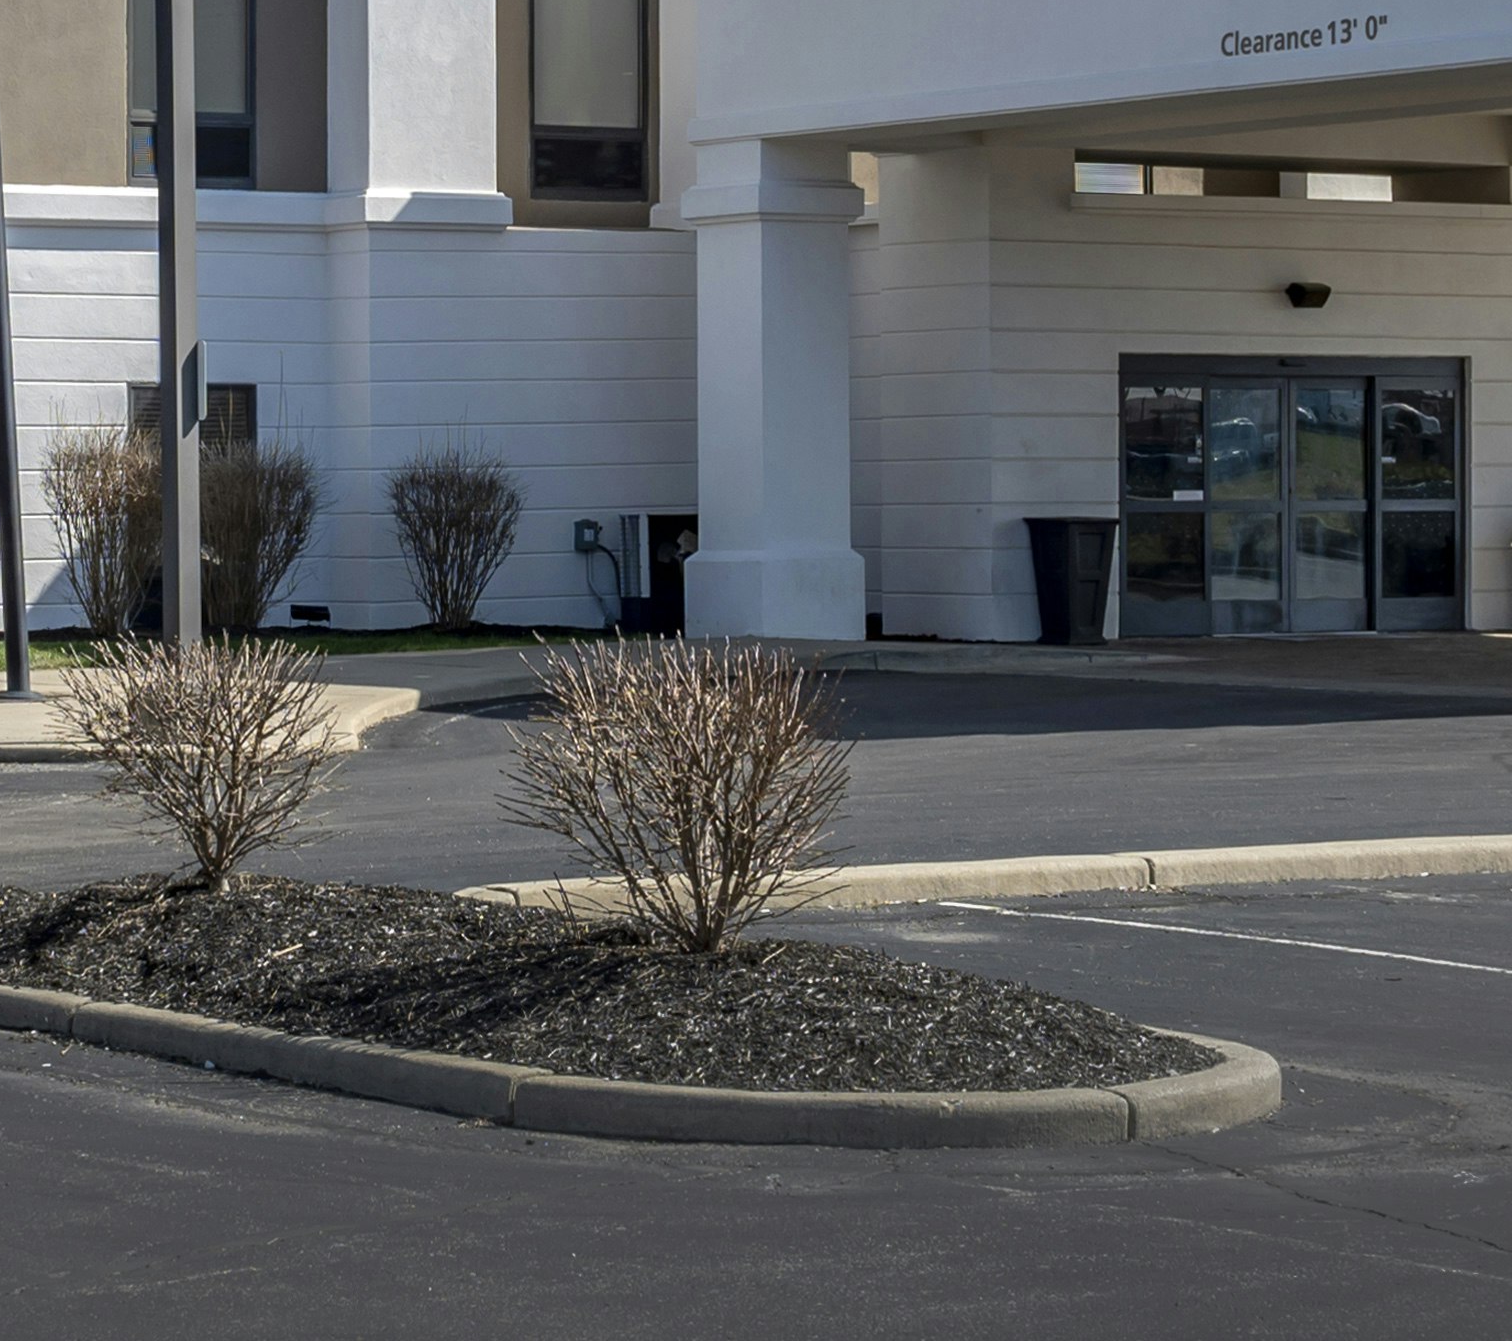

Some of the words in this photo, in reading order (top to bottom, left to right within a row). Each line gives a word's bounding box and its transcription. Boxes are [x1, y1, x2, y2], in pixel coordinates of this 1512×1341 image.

[1220, 28, 1323, 57] Clearance
[1327, 18, 1358, 45] 13'
[1364, 14, 1388, 41] 0"
